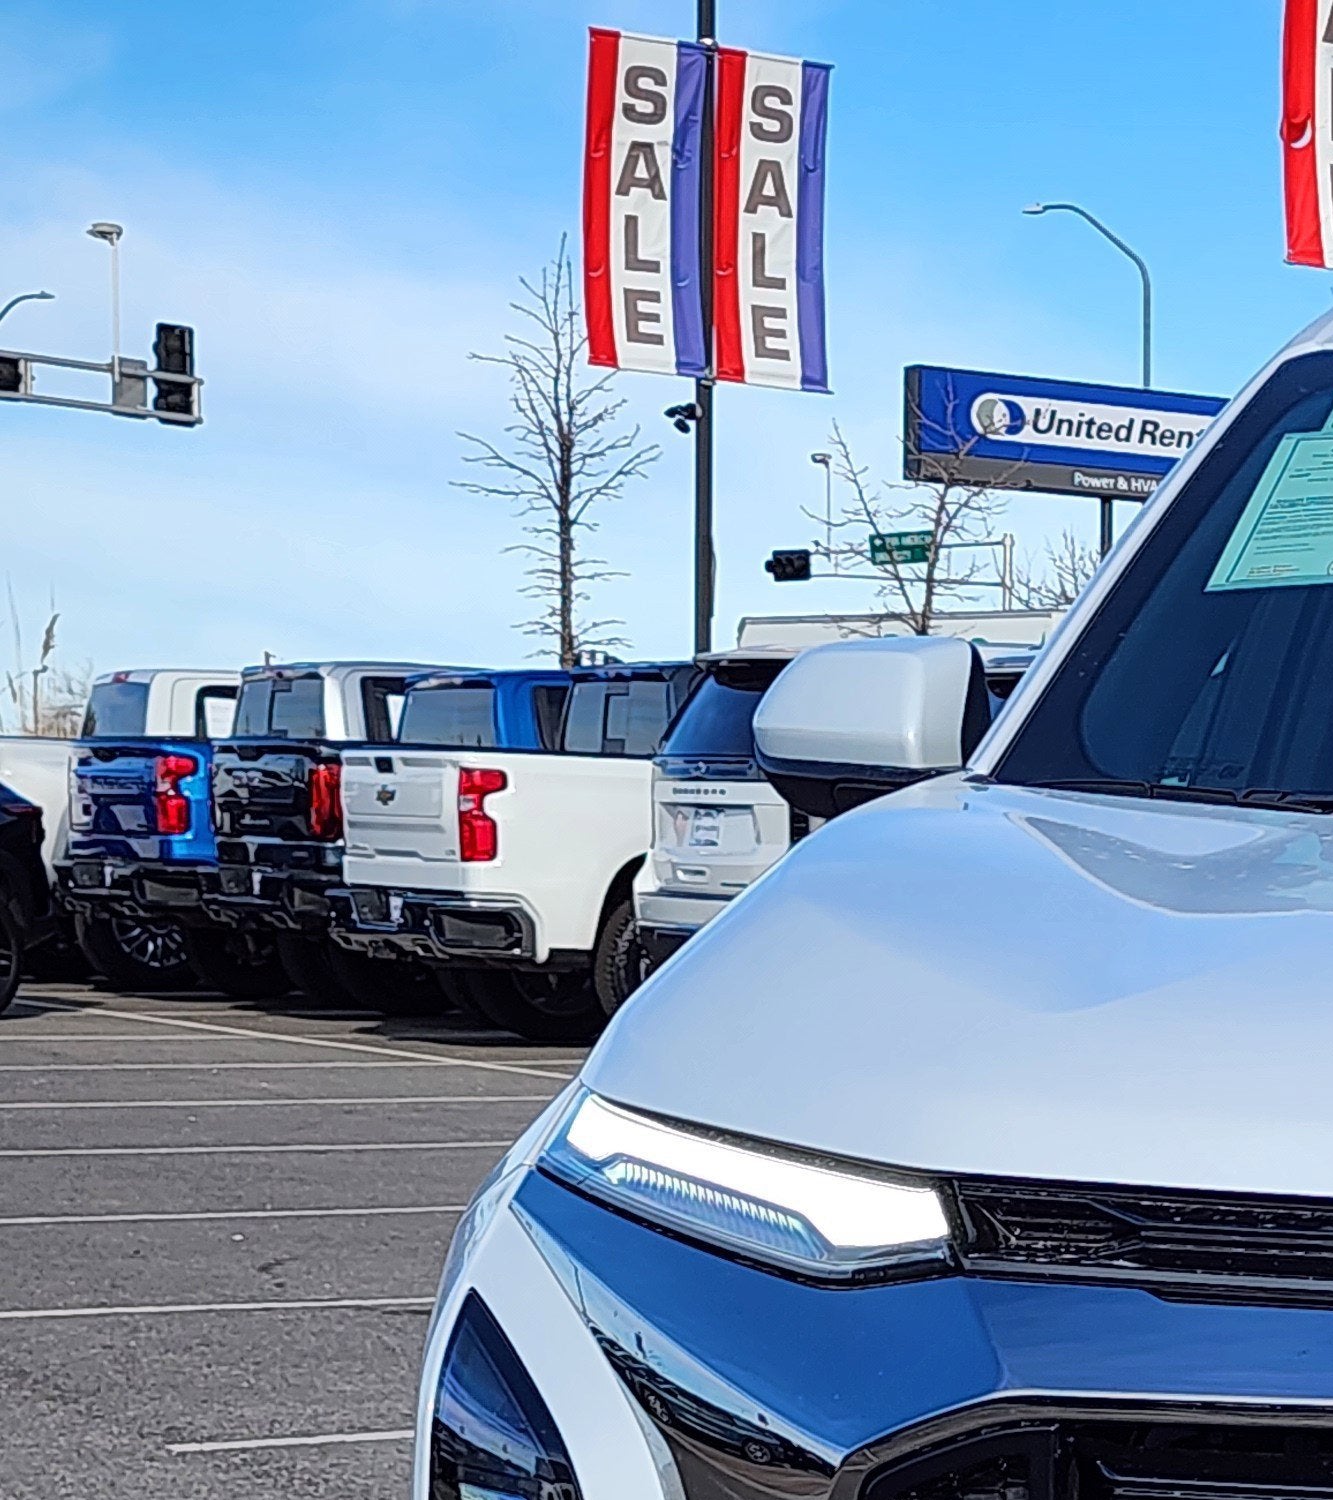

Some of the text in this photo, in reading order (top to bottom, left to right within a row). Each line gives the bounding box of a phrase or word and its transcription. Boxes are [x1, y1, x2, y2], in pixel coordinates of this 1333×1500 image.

[615, 66, 667, 345] SALE
[743, 85, 793, 361] SALE
[1032, 408, 1205, 449] United Ren
[1073, 471, 1161, 492] Power & HVA
